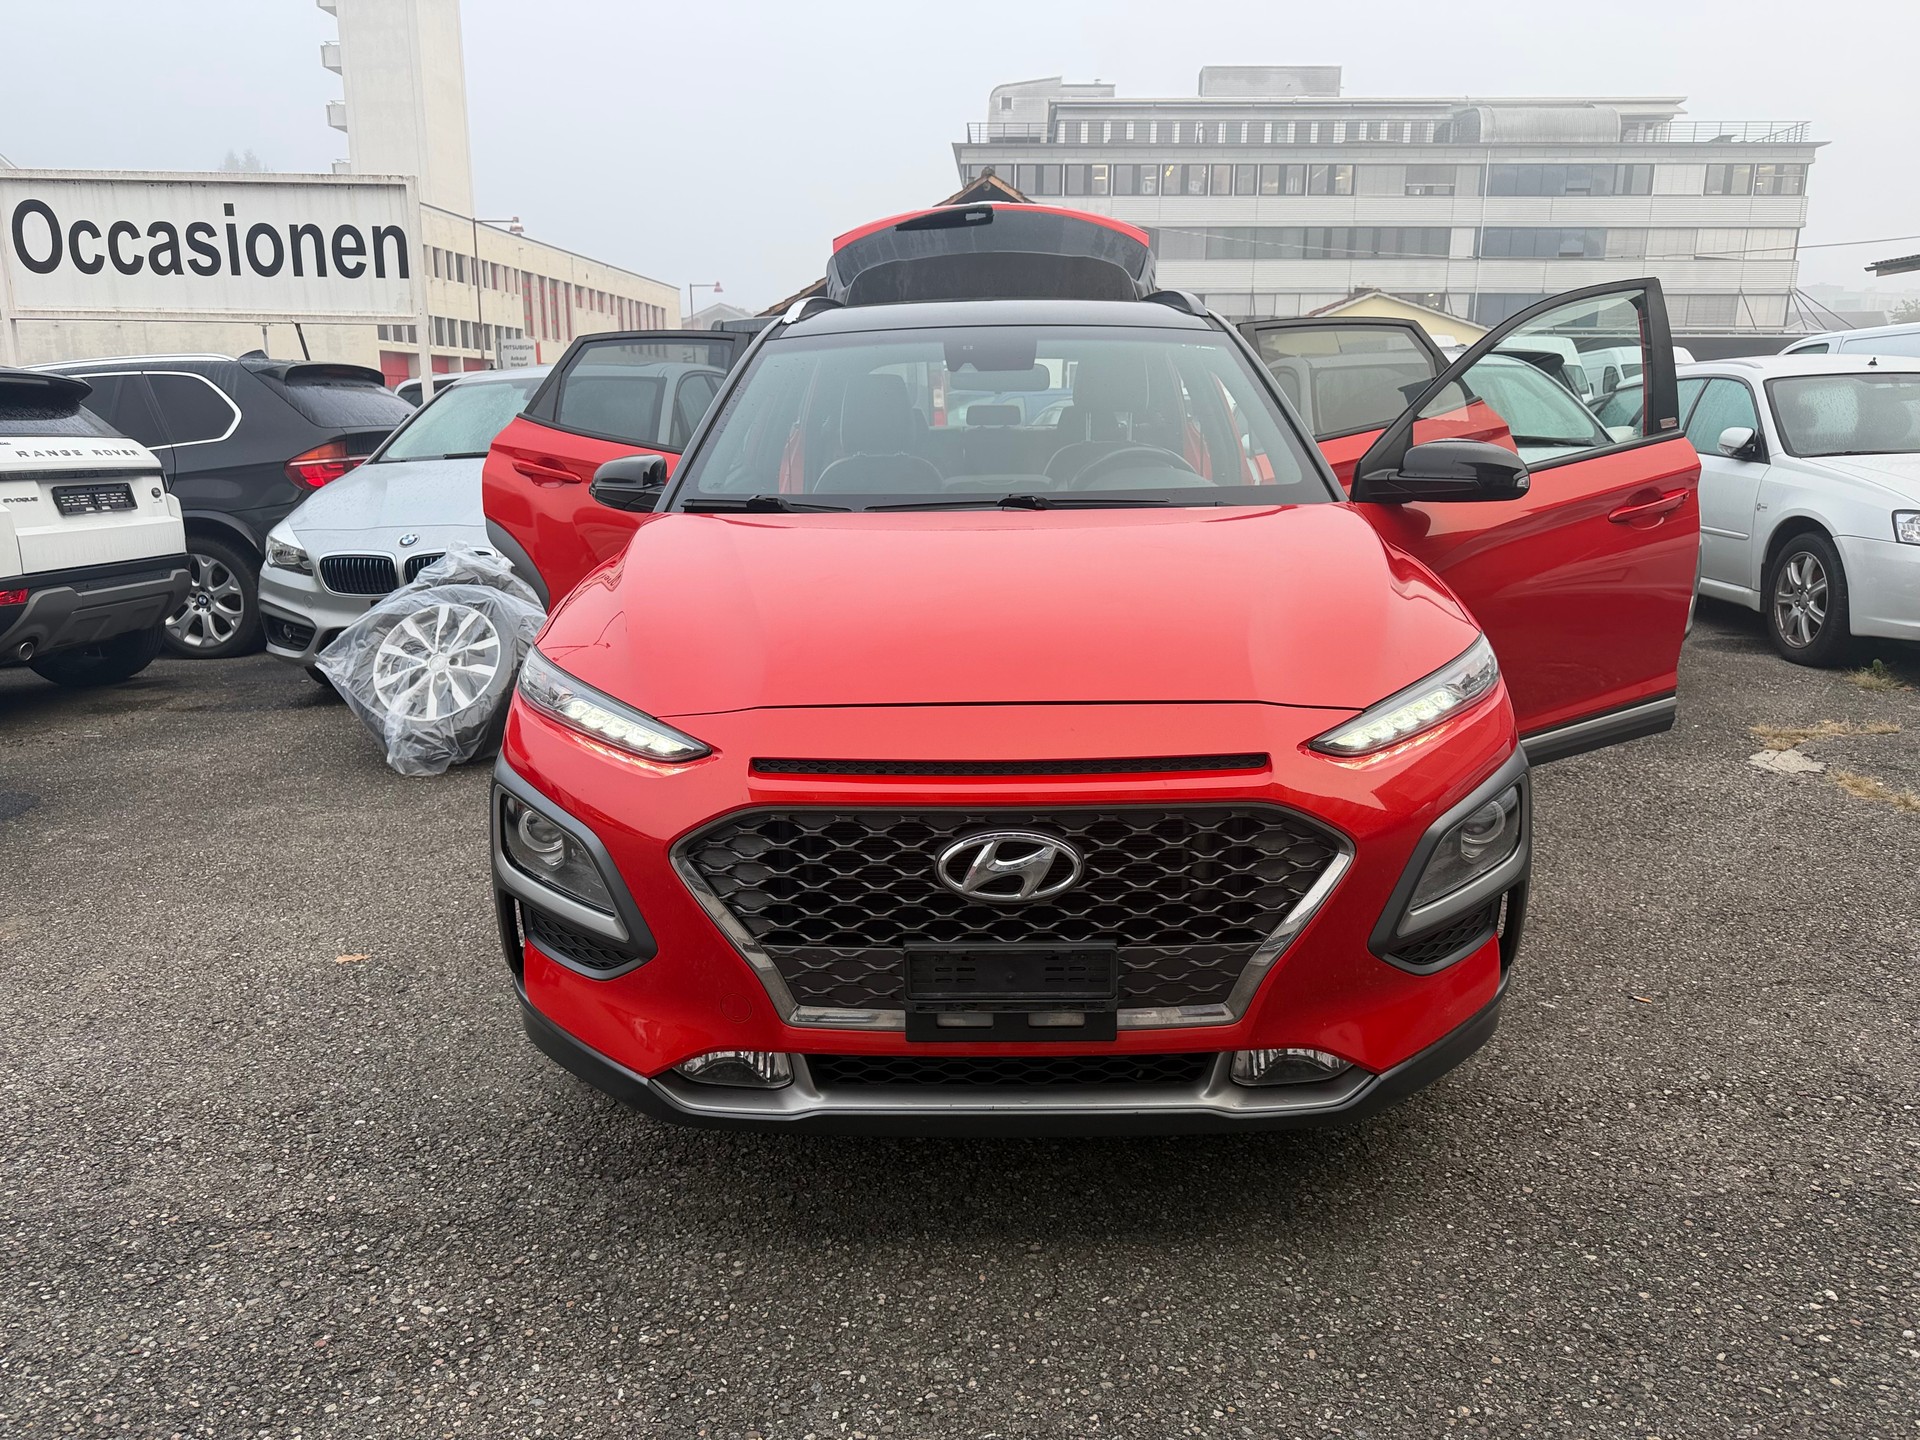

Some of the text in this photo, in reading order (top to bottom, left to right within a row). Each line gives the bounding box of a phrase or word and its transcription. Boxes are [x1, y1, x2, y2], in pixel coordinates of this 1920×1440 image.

[12, 198, 410, 279] Occasionen
[15, 449, 140, 458] RANGE ROVER
